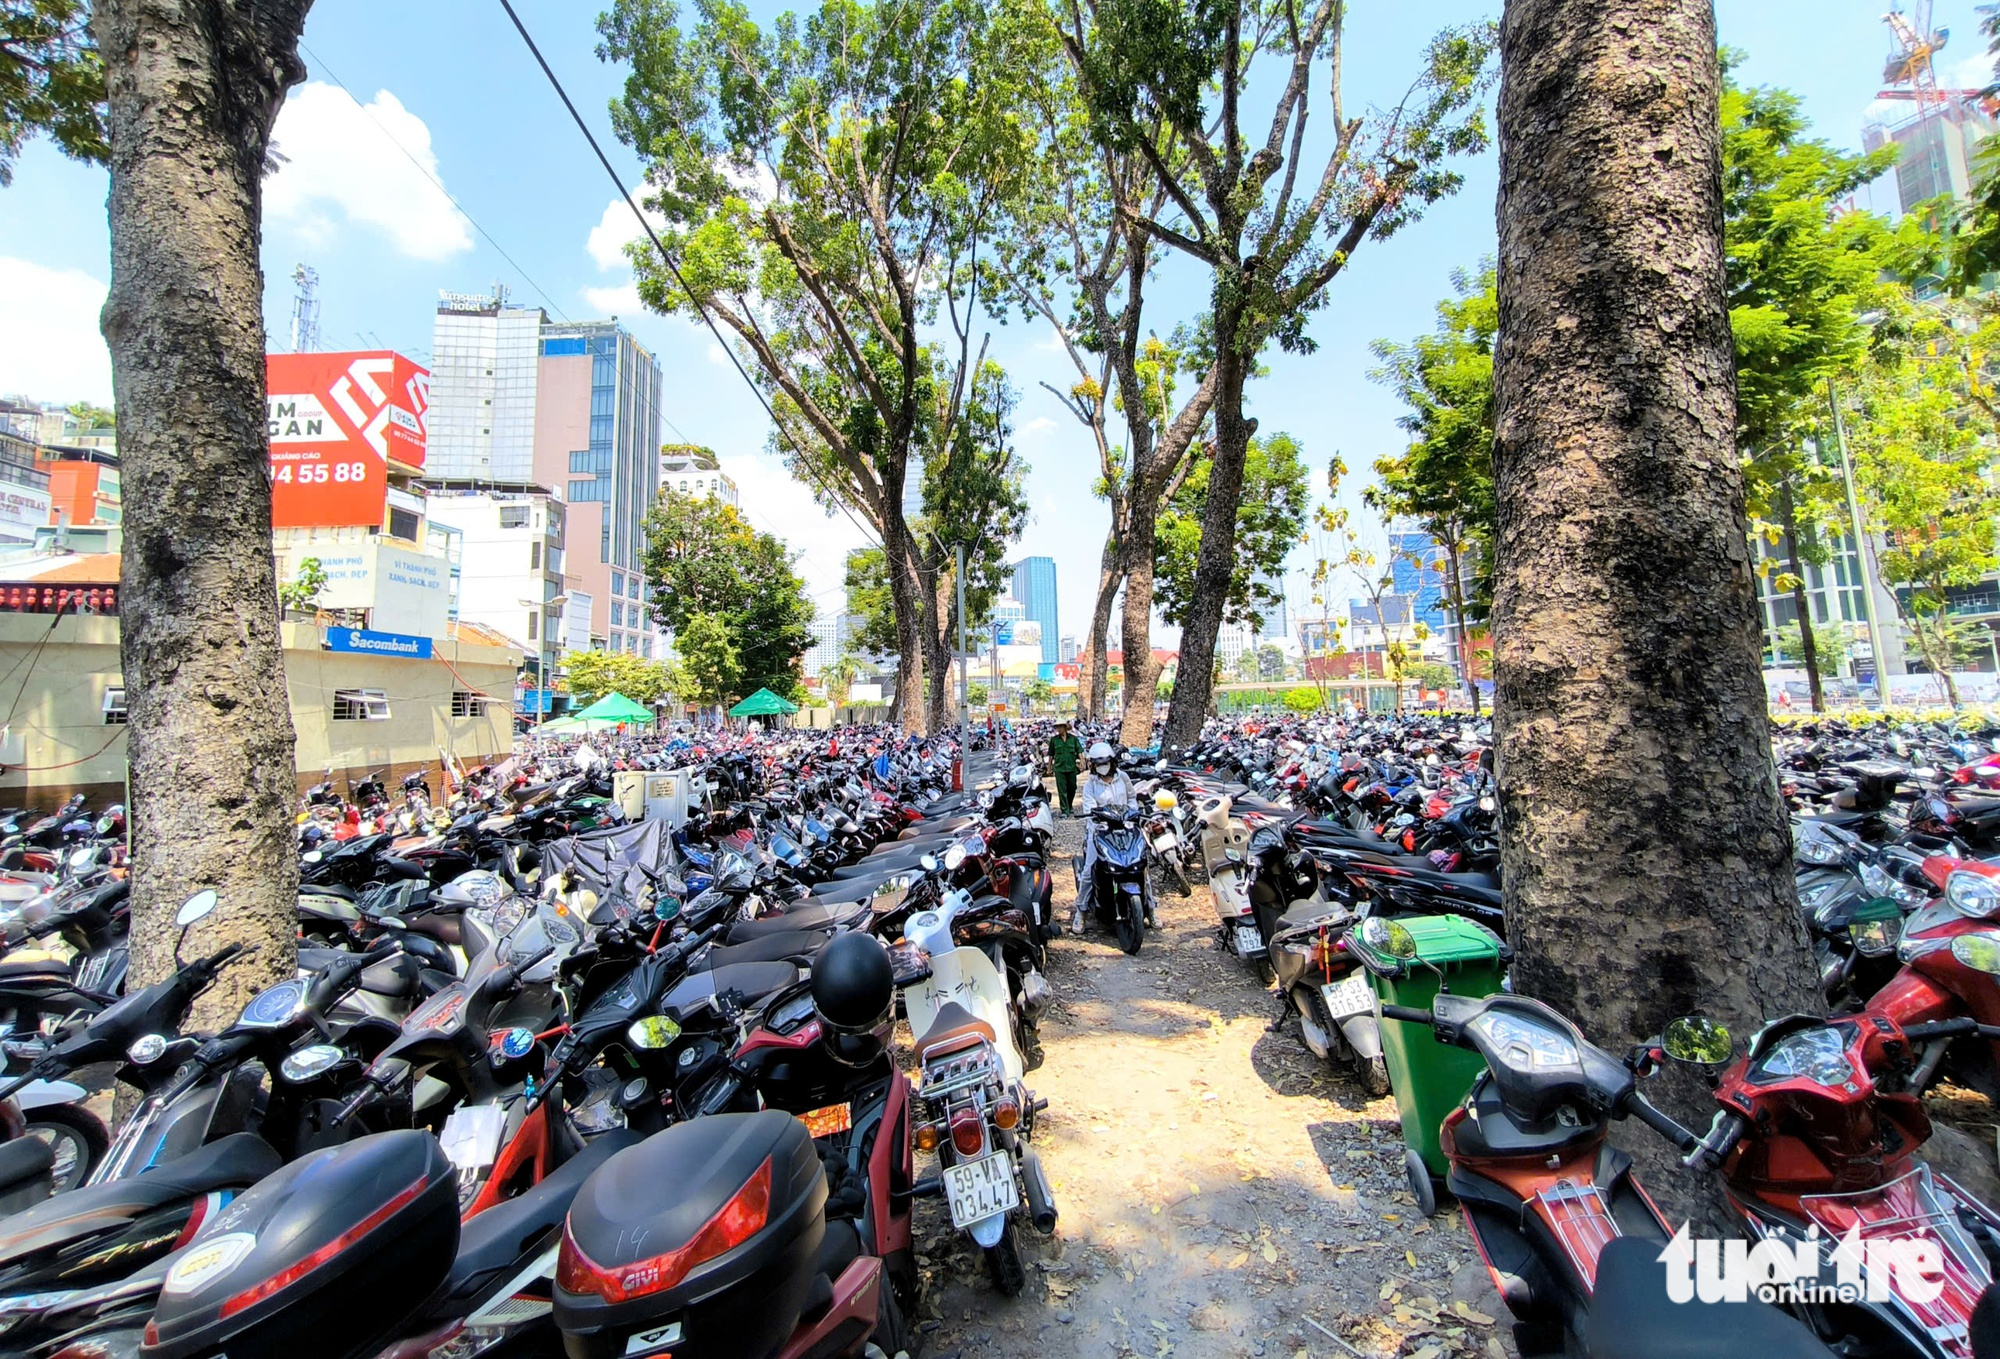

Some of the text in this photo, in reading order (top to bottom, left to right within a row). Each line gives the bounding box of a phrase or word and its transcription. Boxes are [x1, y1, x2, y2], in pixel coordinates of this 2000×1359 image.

[450, 301, 481, 311] hotel
[267, 402, 323, 418] IM GROUP
[267, 419, 323, 437] GAN
[298, 463, 329, 484] 55
[334, 462, 366, 482] 88
[348, 631, 419, 653] Sacombank
[1243, 938, 1261, 951] 292
[1329, 979, 1363, 999] 59-S3
[954, 1157, 1002, 1193] 59-VA
[954, 1180, 1010, 1221] 034.47
[621, 1267, 659, 1291] GIVI
